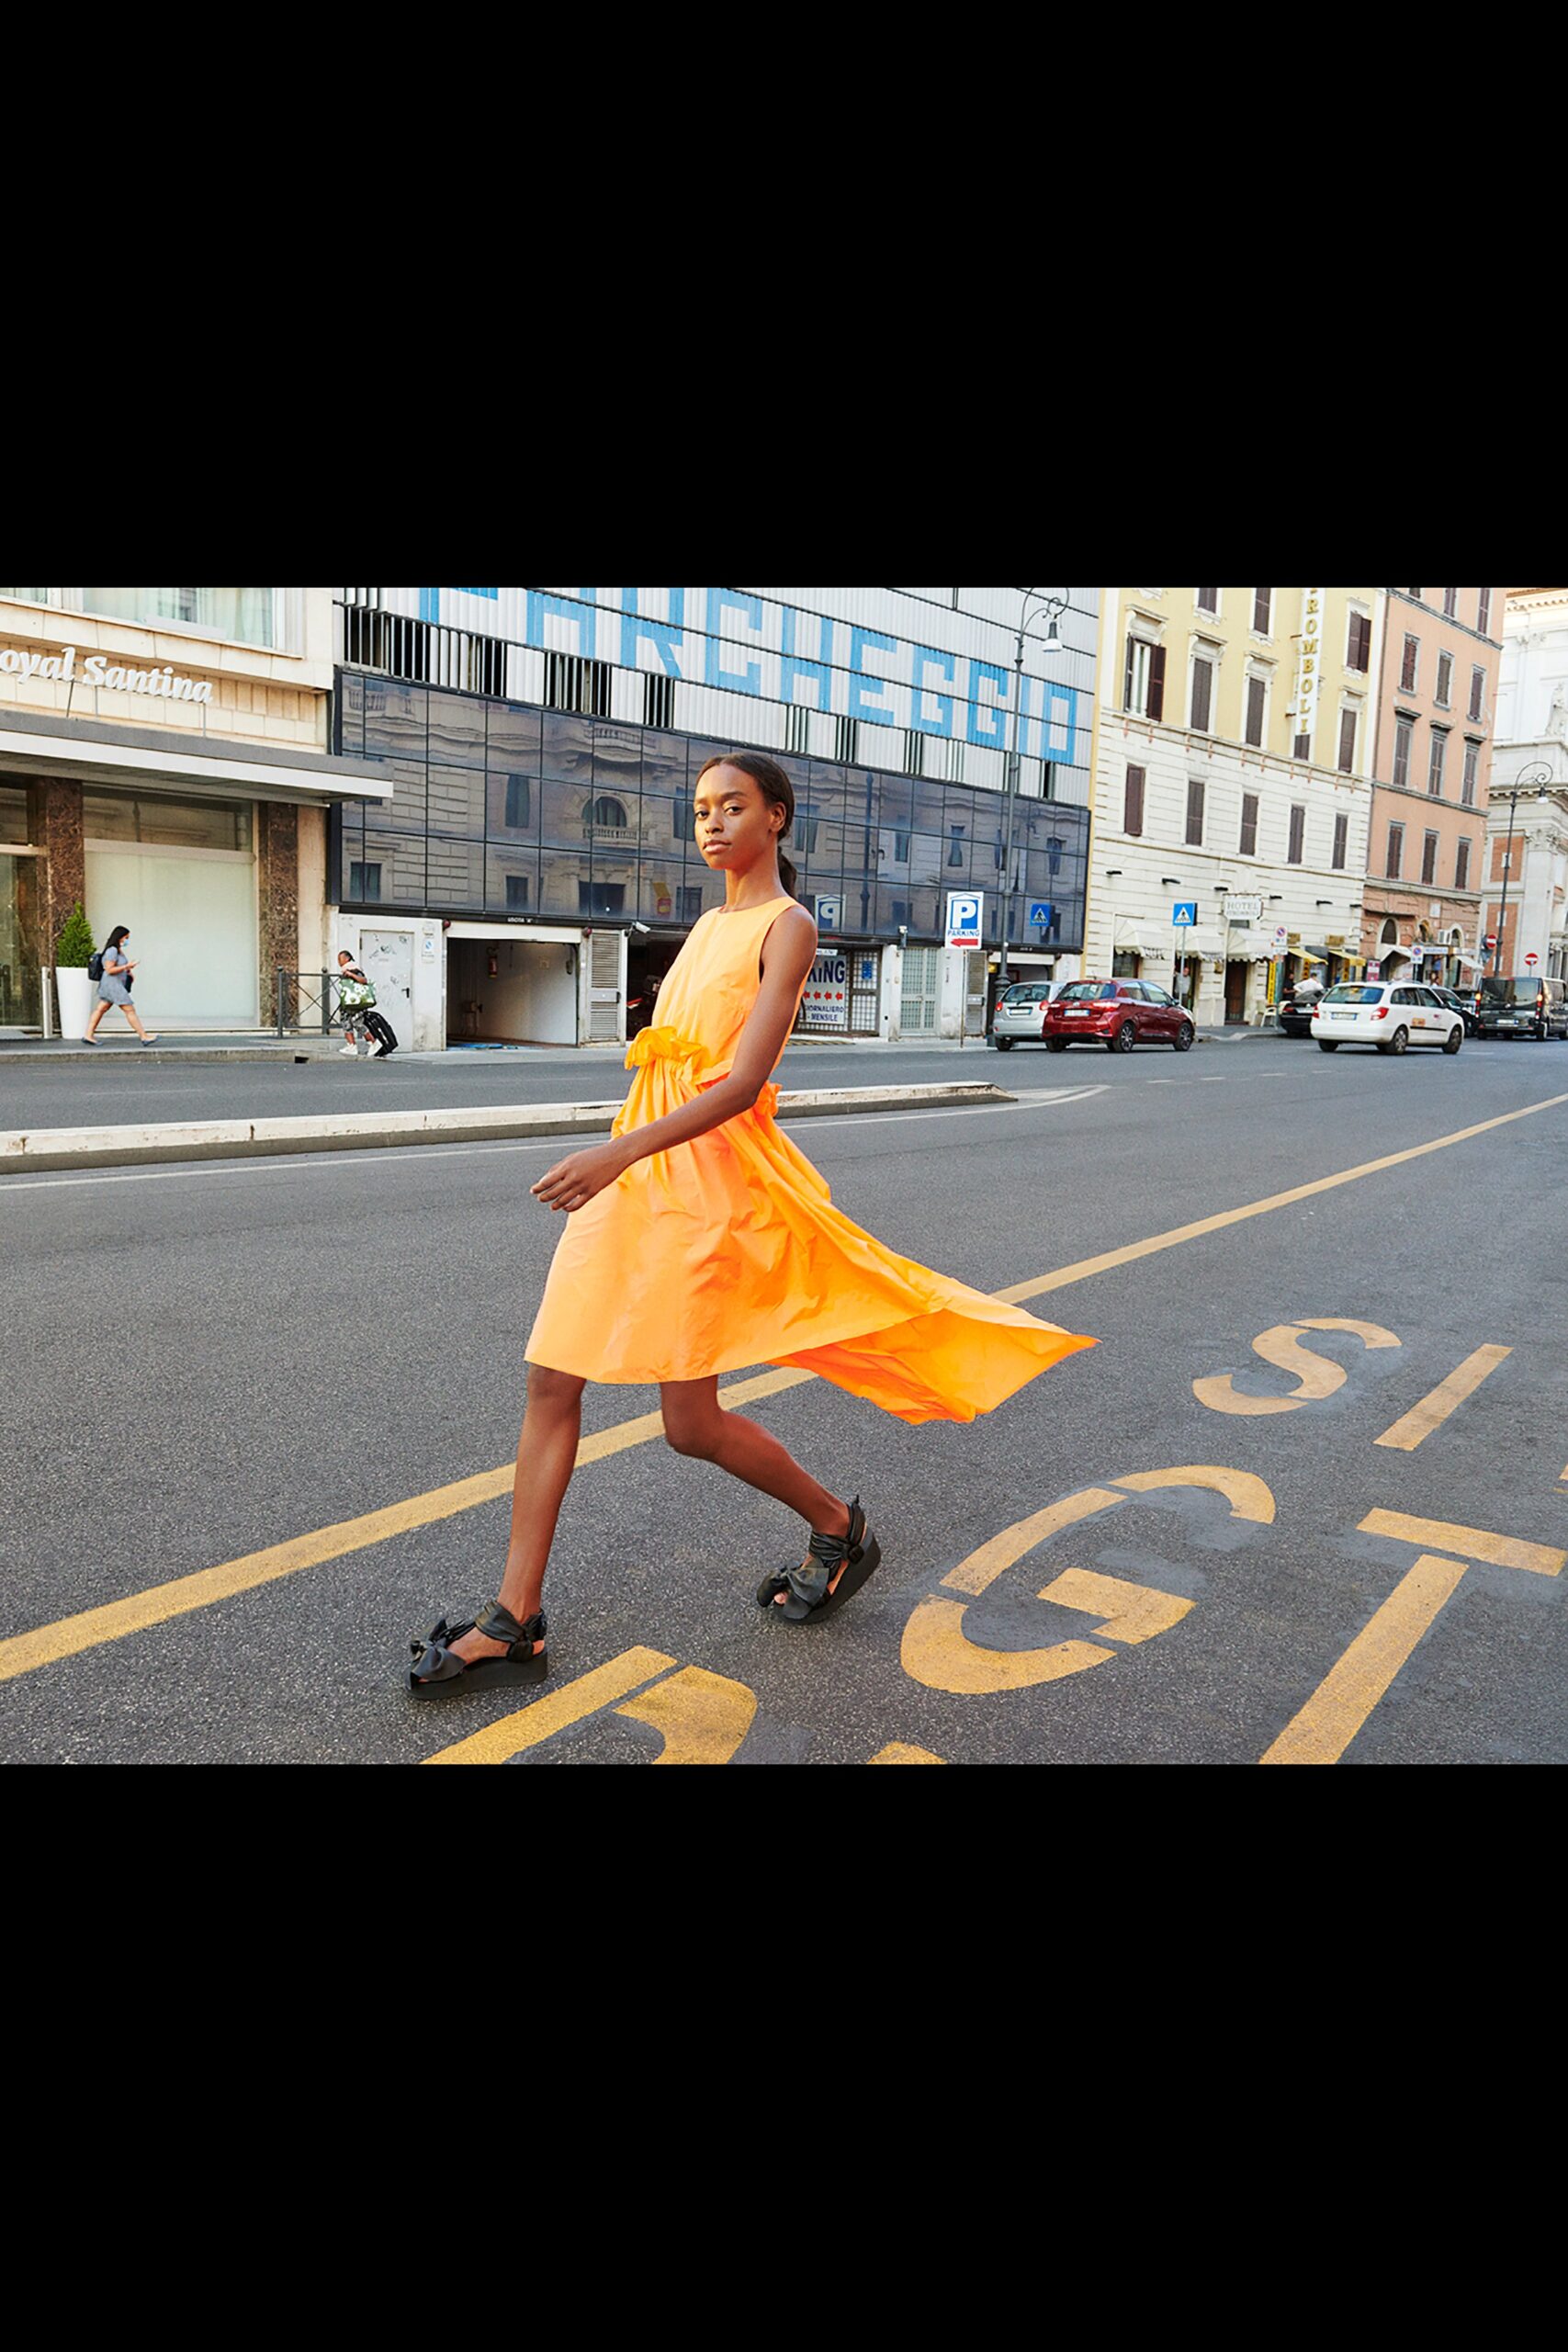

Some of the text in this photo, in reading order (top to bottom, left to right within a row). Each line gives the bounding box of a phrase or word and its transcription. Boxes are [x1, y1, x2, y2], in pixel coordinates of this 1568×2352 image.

[1300, 588, 1318, 732] ROMBOLI
[83, 656, 213, 704] Santina
[952, 901, 976, 929] P
[1226, 901, 1258, 910] HOTEL
[811, 1012, 838, 1022] MENSILE
